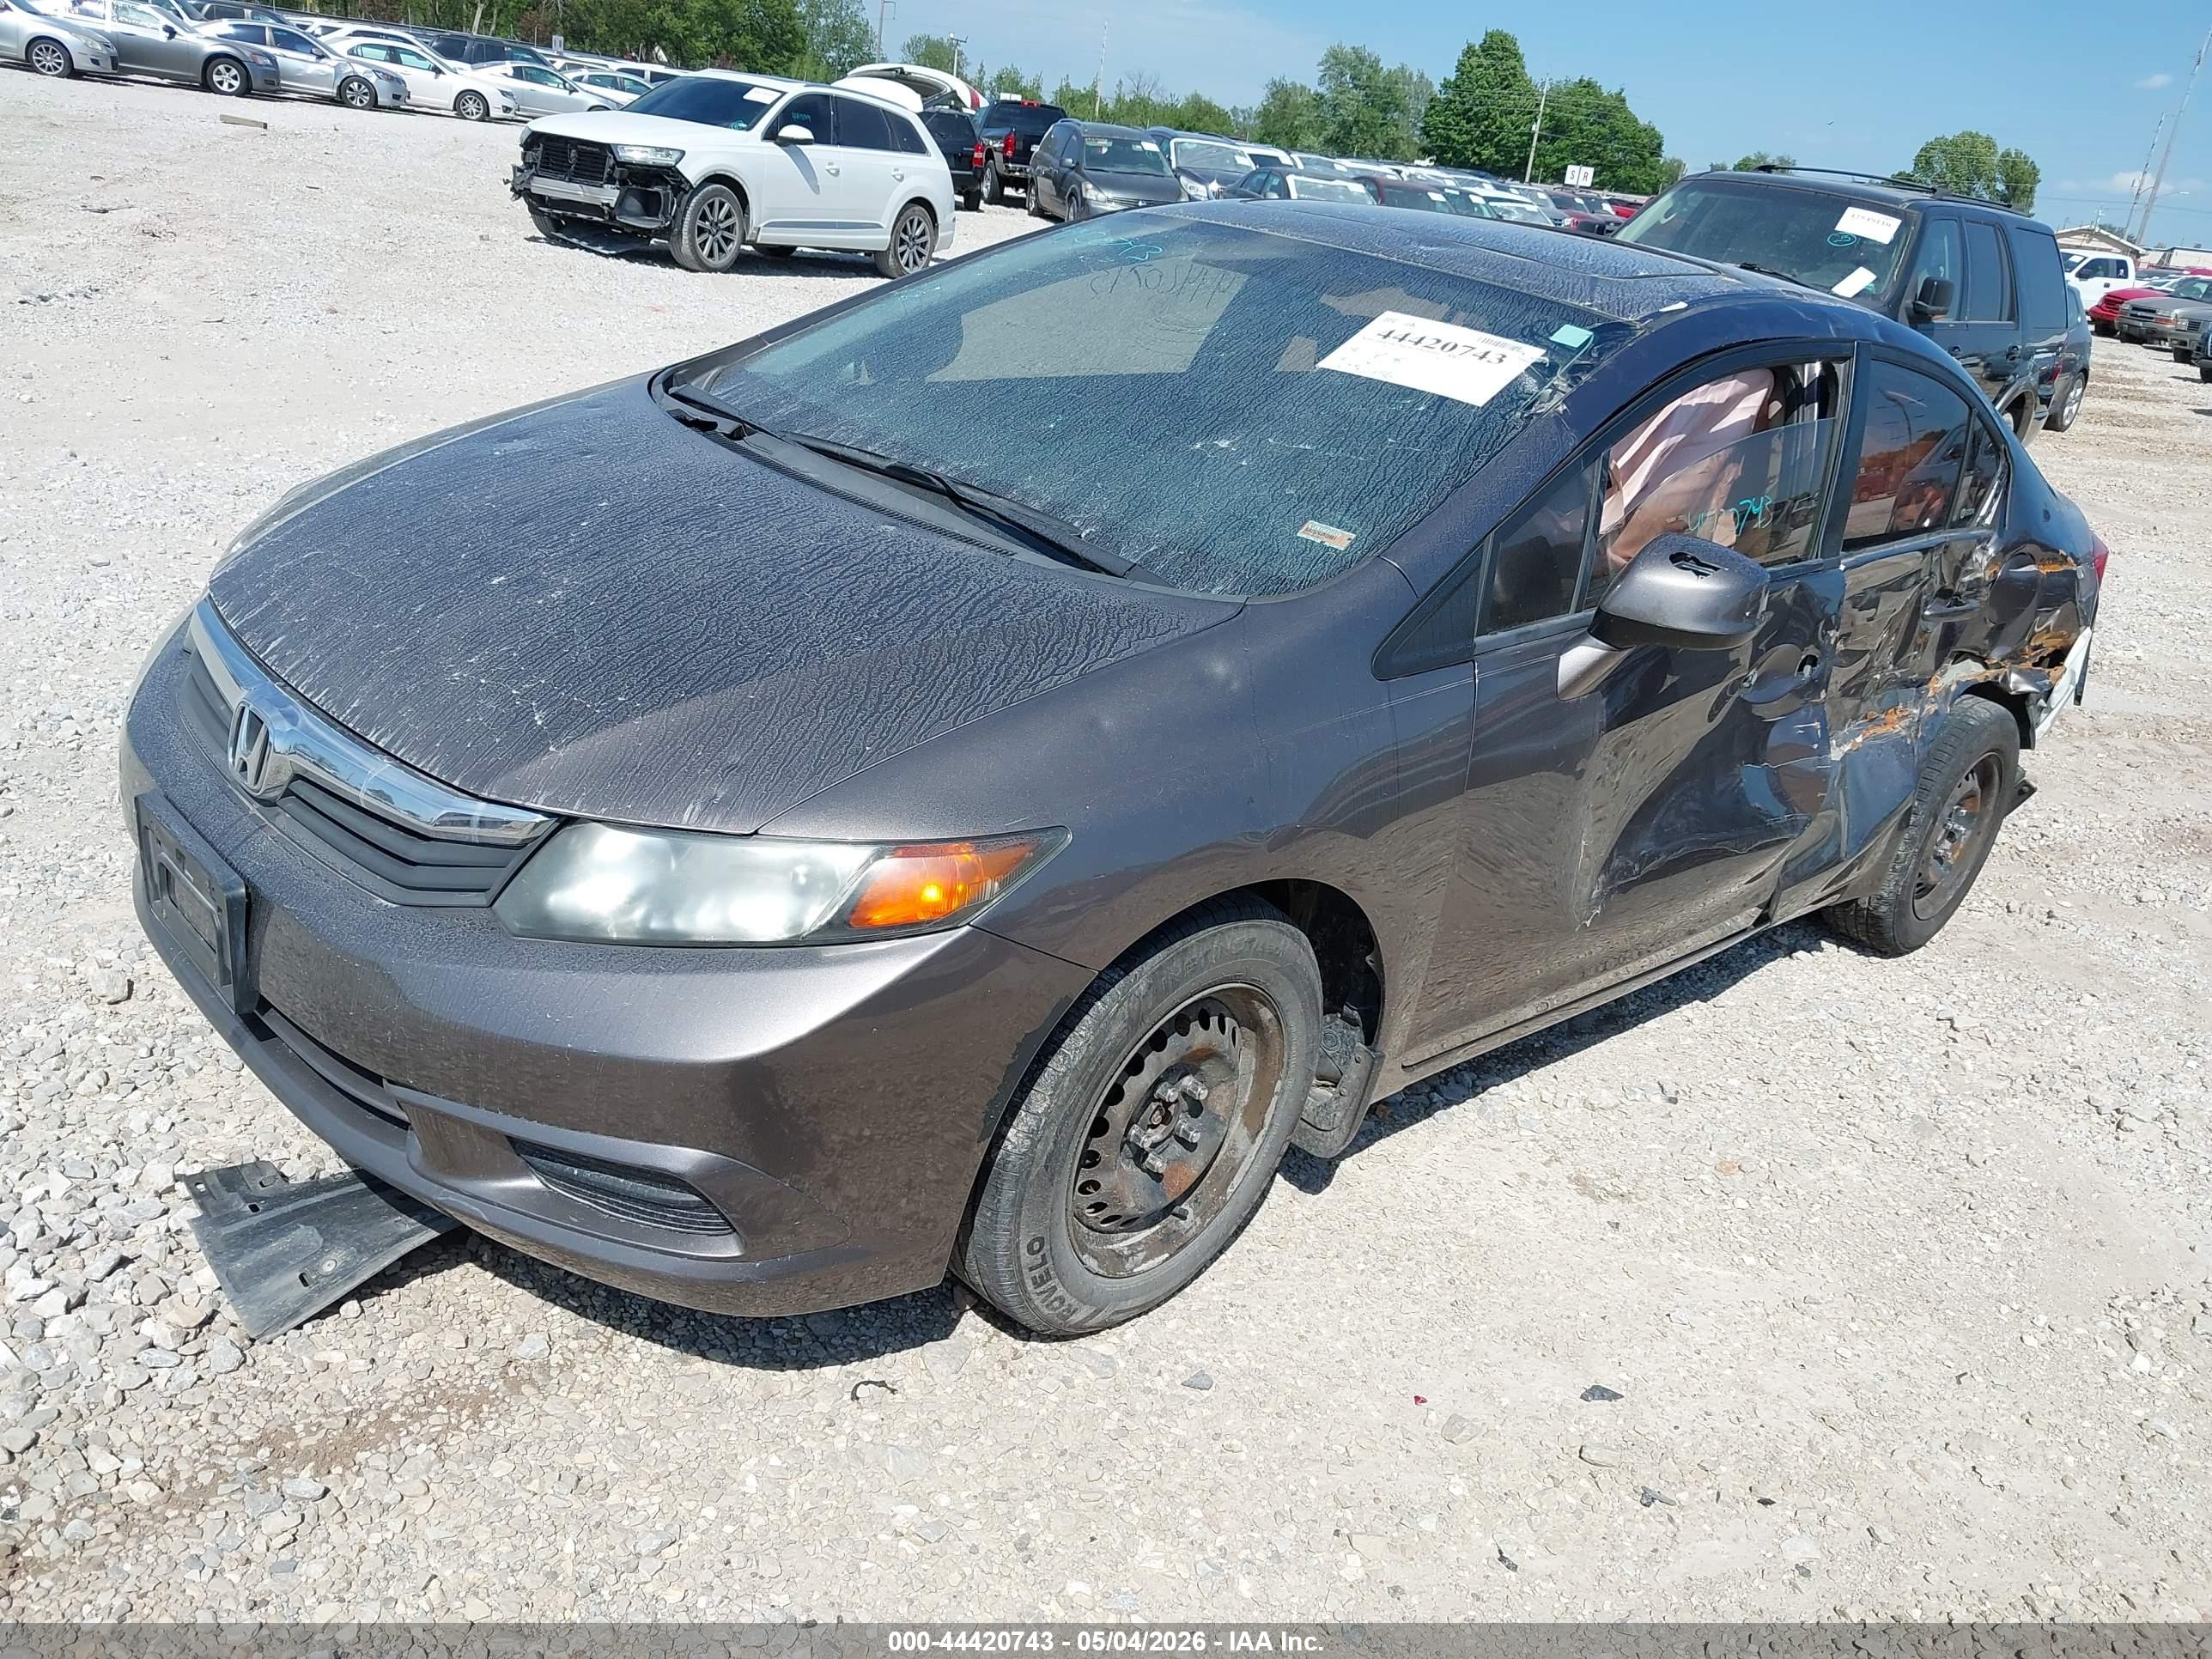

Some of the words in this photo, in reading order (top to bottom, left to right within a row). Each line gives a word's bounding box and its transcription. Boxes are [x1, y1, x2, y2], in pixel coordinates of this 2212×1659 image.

[1570, 170, 1576, 180] S
[1376, 329, 1508, 365] 44420743
[1026, 1236, 1079, 1321] ROVELO
